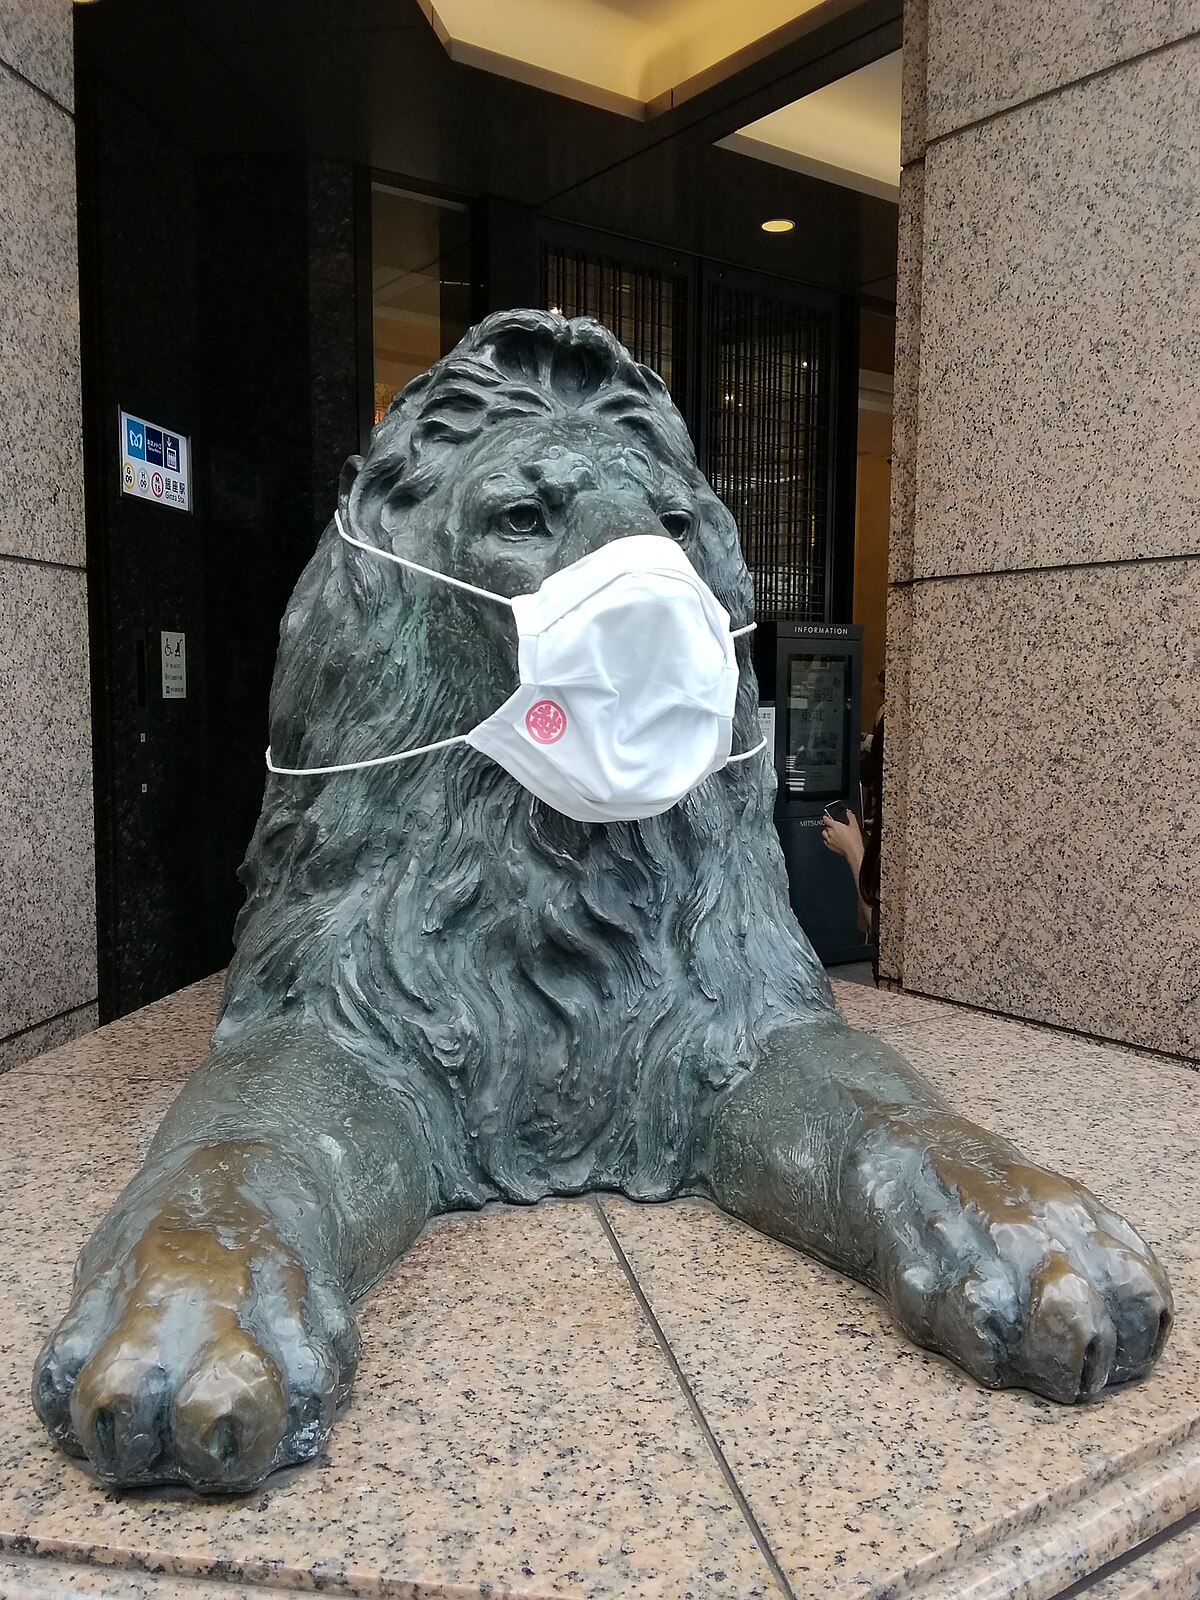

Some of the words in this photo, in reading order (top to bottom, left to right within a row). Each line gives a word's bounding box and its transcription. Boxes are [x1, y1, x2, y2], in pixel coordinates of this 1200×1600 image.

[126, 466, 131, 475] G
[141, 471, 146, 479] H
[125, 475, 133, 484] 09
[140, 479, 147, 488] 09
[165, 477, 186, 495] 銀座駅
[165, 491, 177, 502] Ginza
[794, 626, 848, 635] INFORMATION
[800, 819, 826, 827] MITSUKO
